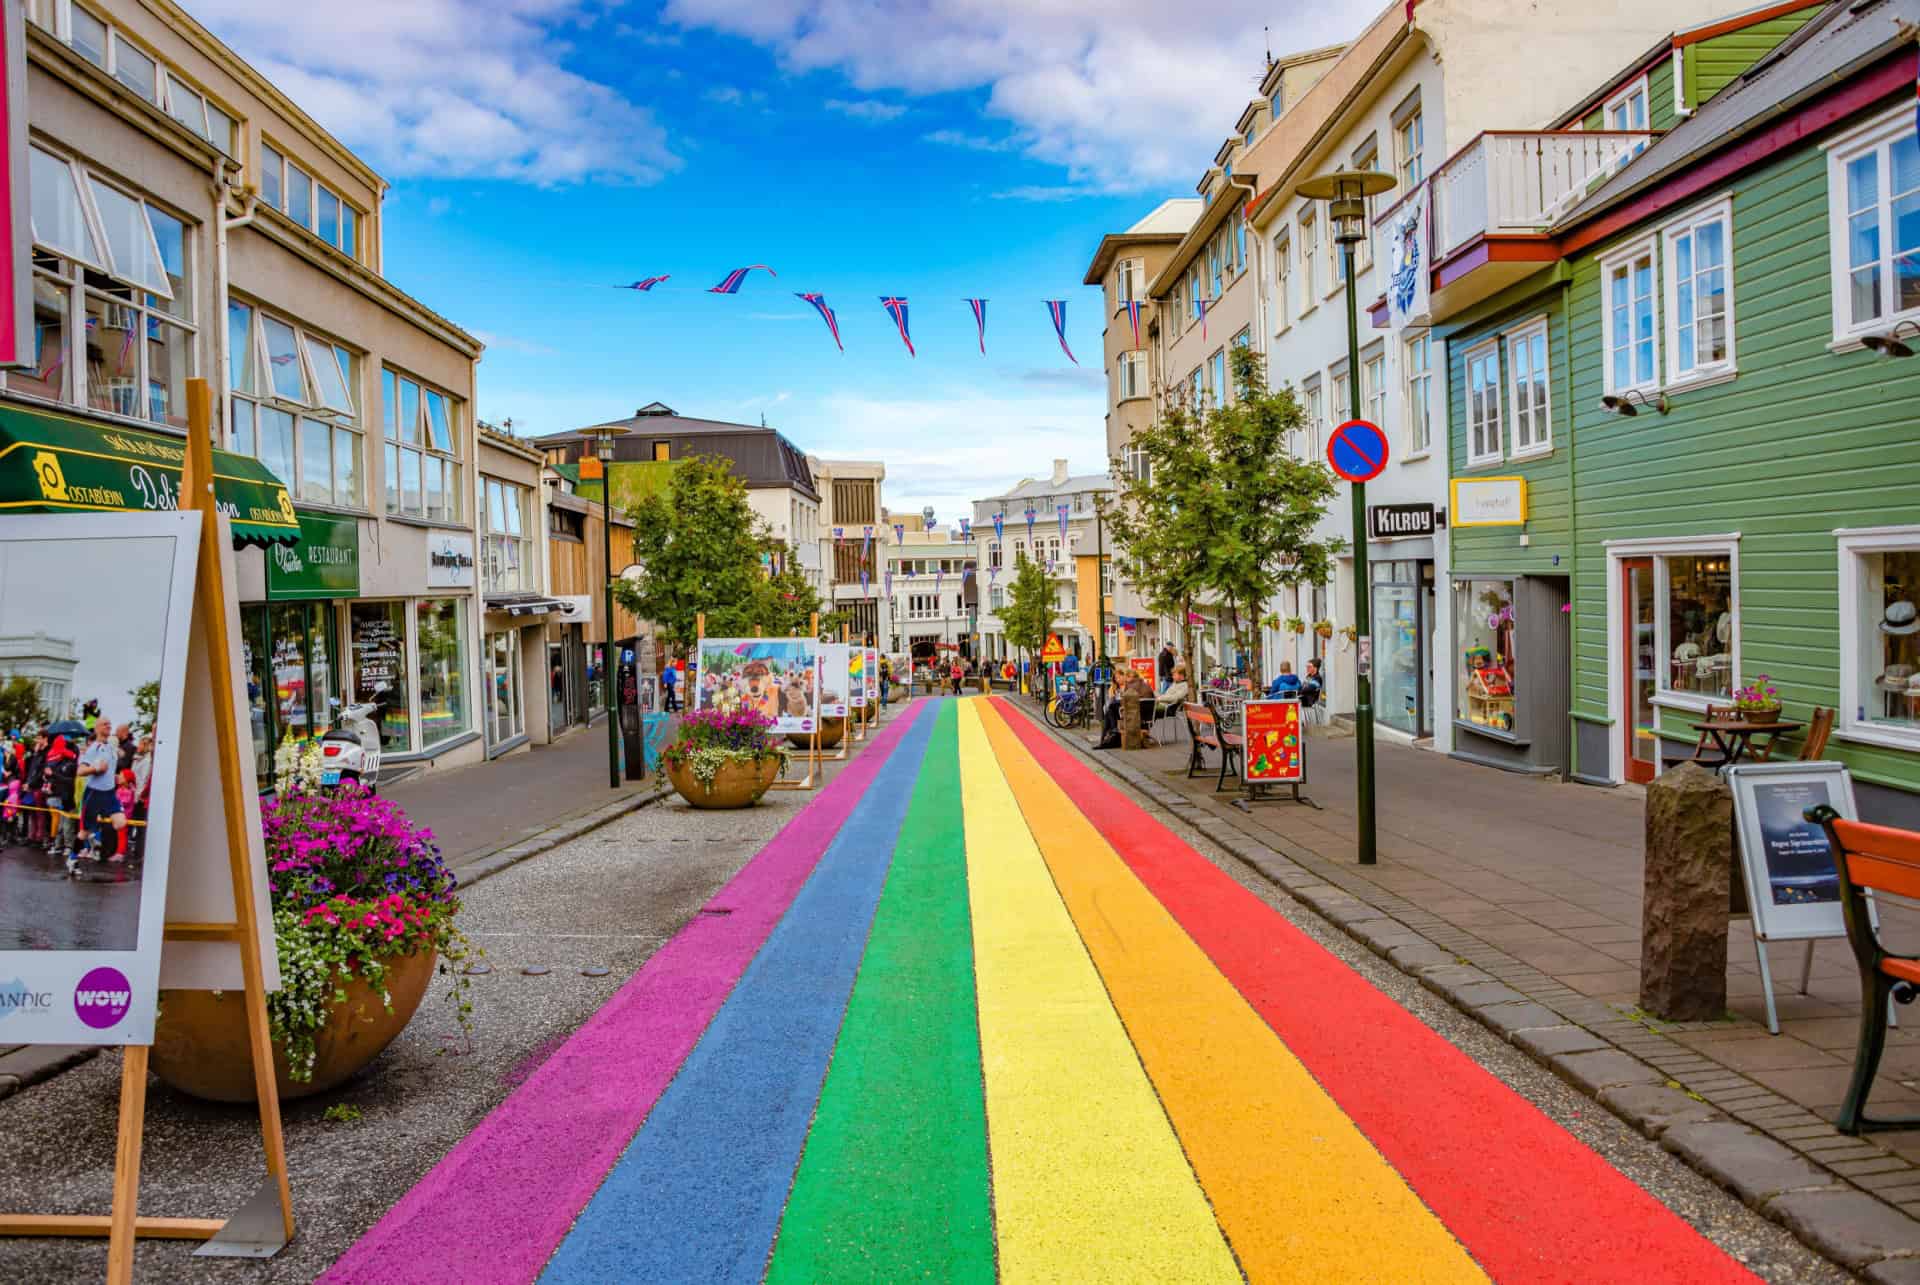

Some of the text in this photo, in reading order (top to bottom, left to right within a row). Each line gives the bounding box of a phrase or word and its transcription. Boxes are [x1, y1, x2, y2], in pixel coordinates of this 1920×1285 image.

[1377, 509, 1430, 532] KILROY
[308, 545, 352, 566] RESTAURANT
[76, 990, 130, 1007] WOW
